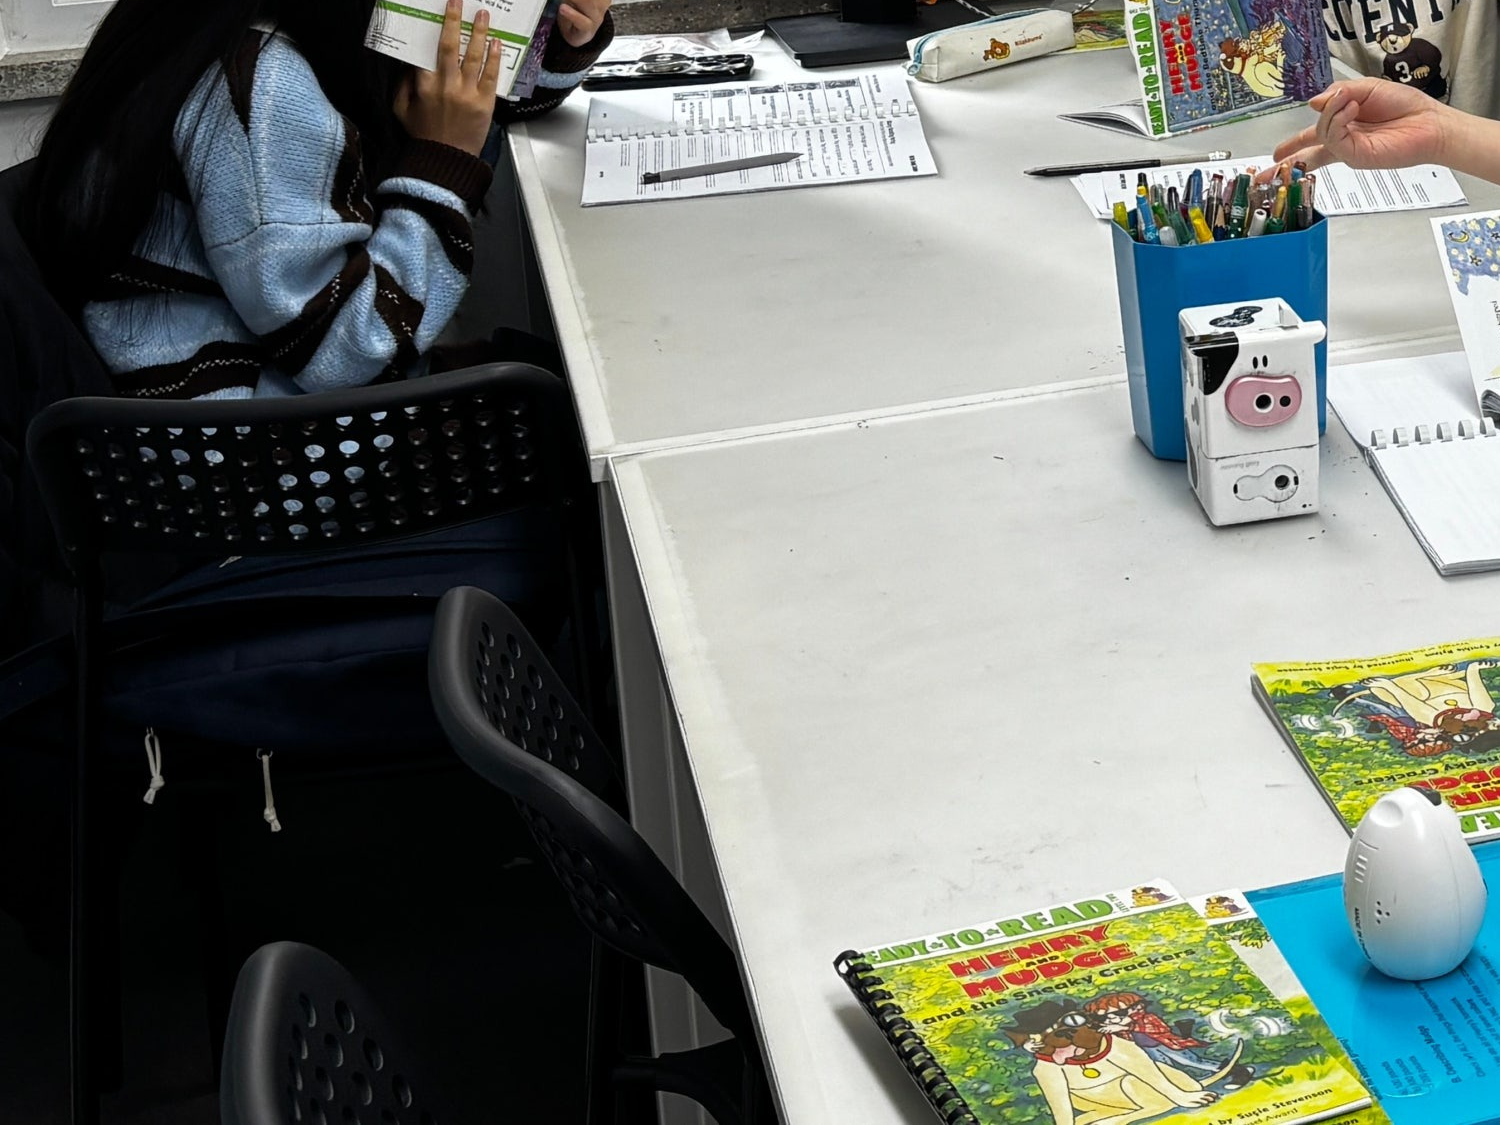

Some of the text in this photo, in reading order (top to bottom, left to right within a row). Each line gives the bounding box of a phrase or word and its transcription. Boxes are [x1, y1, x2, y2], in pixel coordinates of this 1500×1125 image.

[1157, 18, 1185, 95] HENRY
[1176, 12, 1203, 92] MUDGE
[1128, 11, 1166, 135] READY TO READ
[1204, 71, 1213, 89] the
[1395, 61, 1412, 82] 3
[1208, 91, 1217, 111] and
[1364, 656, 1416, 668] illustrated
[1454, 644, 1491, 652] Cynthia
[1352, 766, 1439, 787] Crackers
[861, 898, 1113, 967] EADY TO READ
[948, 924, 1110, 977] HENRY
[1021, 953, 1062, 968] AND
[962, 943, 1134, 998] MUDGE
[918, 948, 1197, 1026] and the Sneaky Crackers
[1218, 1115, 1233, 1125] by
[1272, 1087, 1333, 1109] Stevenson
[1266, 1108, 1299, 1120] Award
